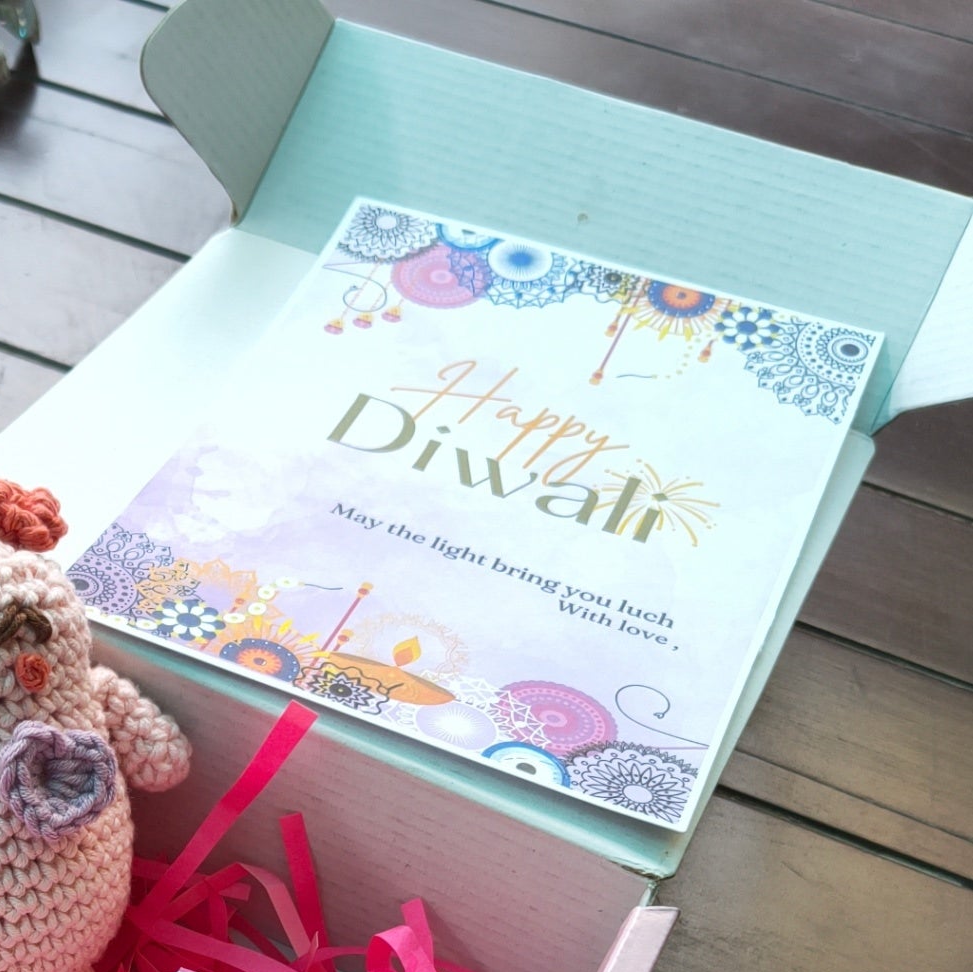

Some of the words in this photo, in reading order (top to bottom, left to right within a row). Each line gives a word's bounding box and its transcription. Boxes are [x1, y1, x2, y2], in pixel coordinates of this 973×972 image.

[326, 393, 669, 543] Diwali
[390, 360, 629, 486] Happy
[330, 502, 383, 530] May
[387, 519, 426, 545] the
[430, 536, 486, 566] light
[491, 558, 561, 594] bring
[561, 585, 612, 608] you
[559, 600, 612, 627] With
